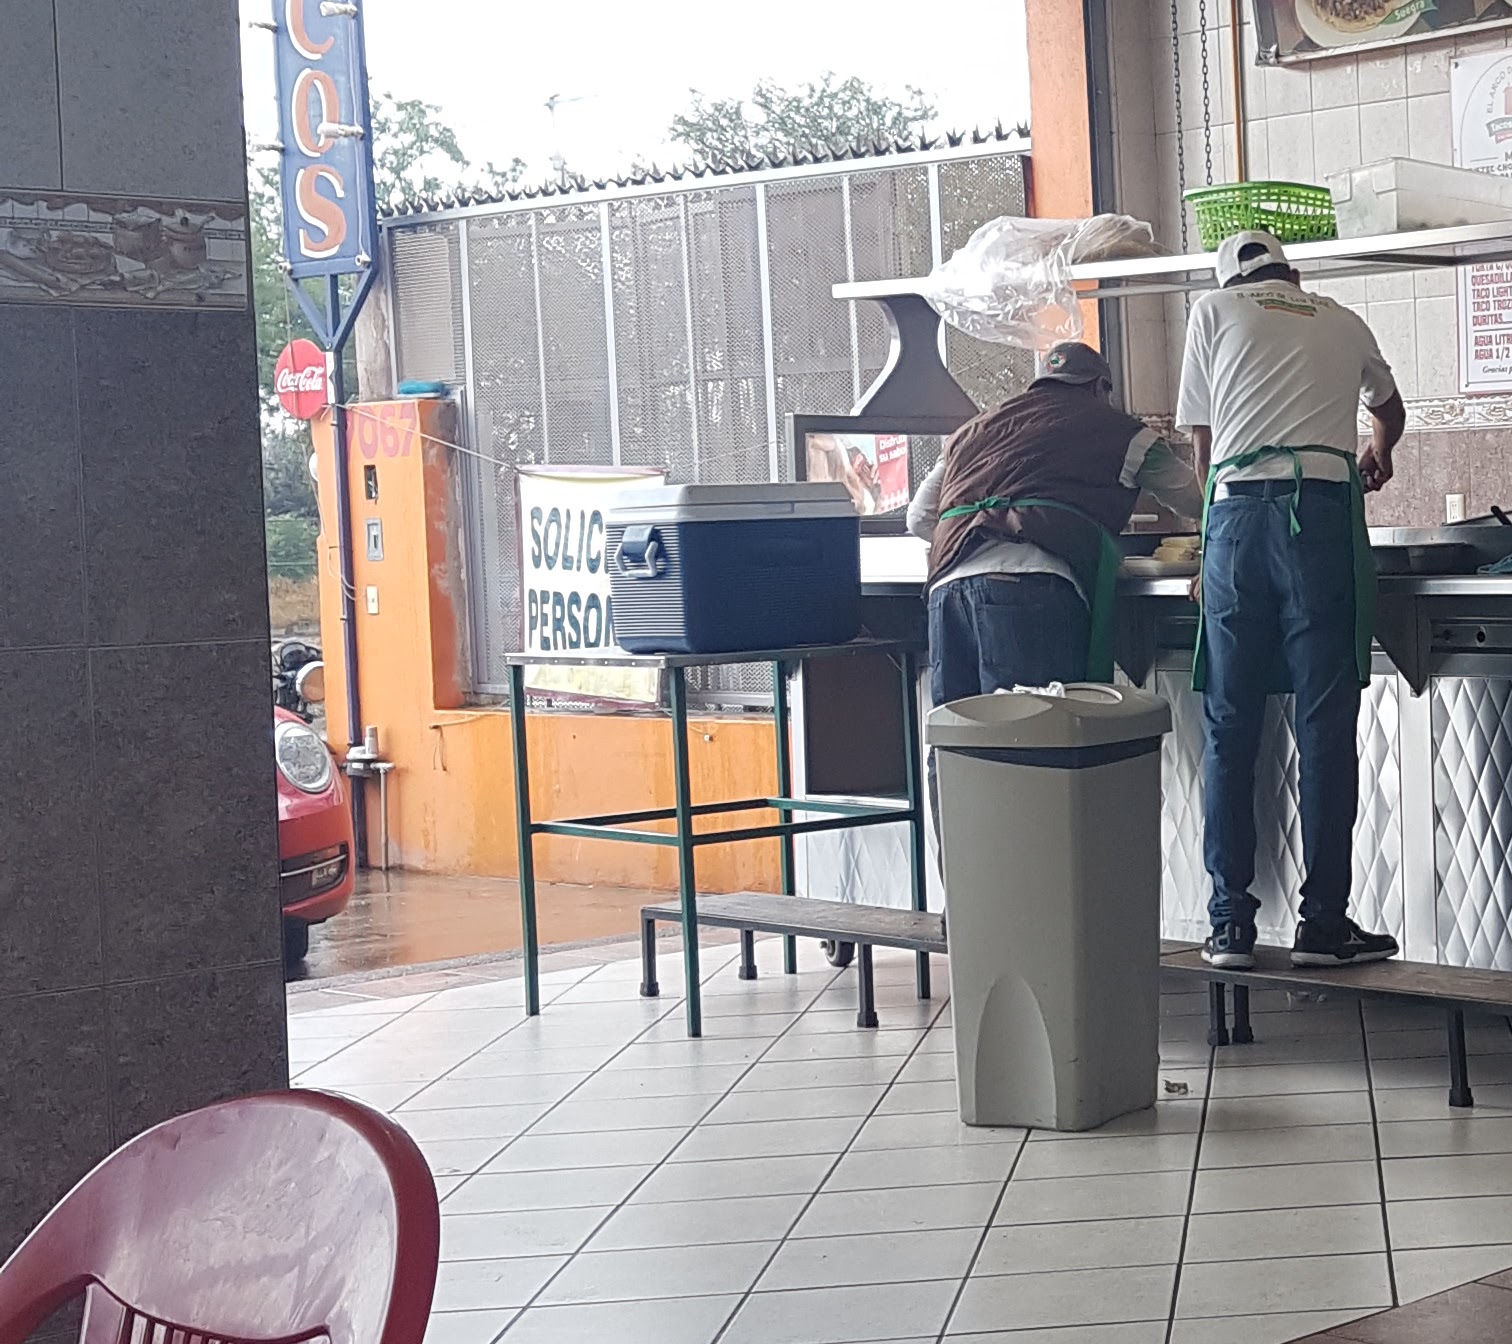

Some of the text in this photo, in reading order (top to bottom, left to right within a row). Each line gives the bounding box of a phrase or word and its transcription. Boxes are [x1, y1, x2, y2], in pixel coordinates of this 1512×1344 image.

[1395, 0, 1426, 20] Suegra
[1489, 71, 1506, 100] ARCO
[1472, 288, 1491, 300] TACO
[1472, 301, 1491, 312] TACO
[1474, 335, 1493, 346] AGUA
[1474, 349, 1493, 361] AGUA
